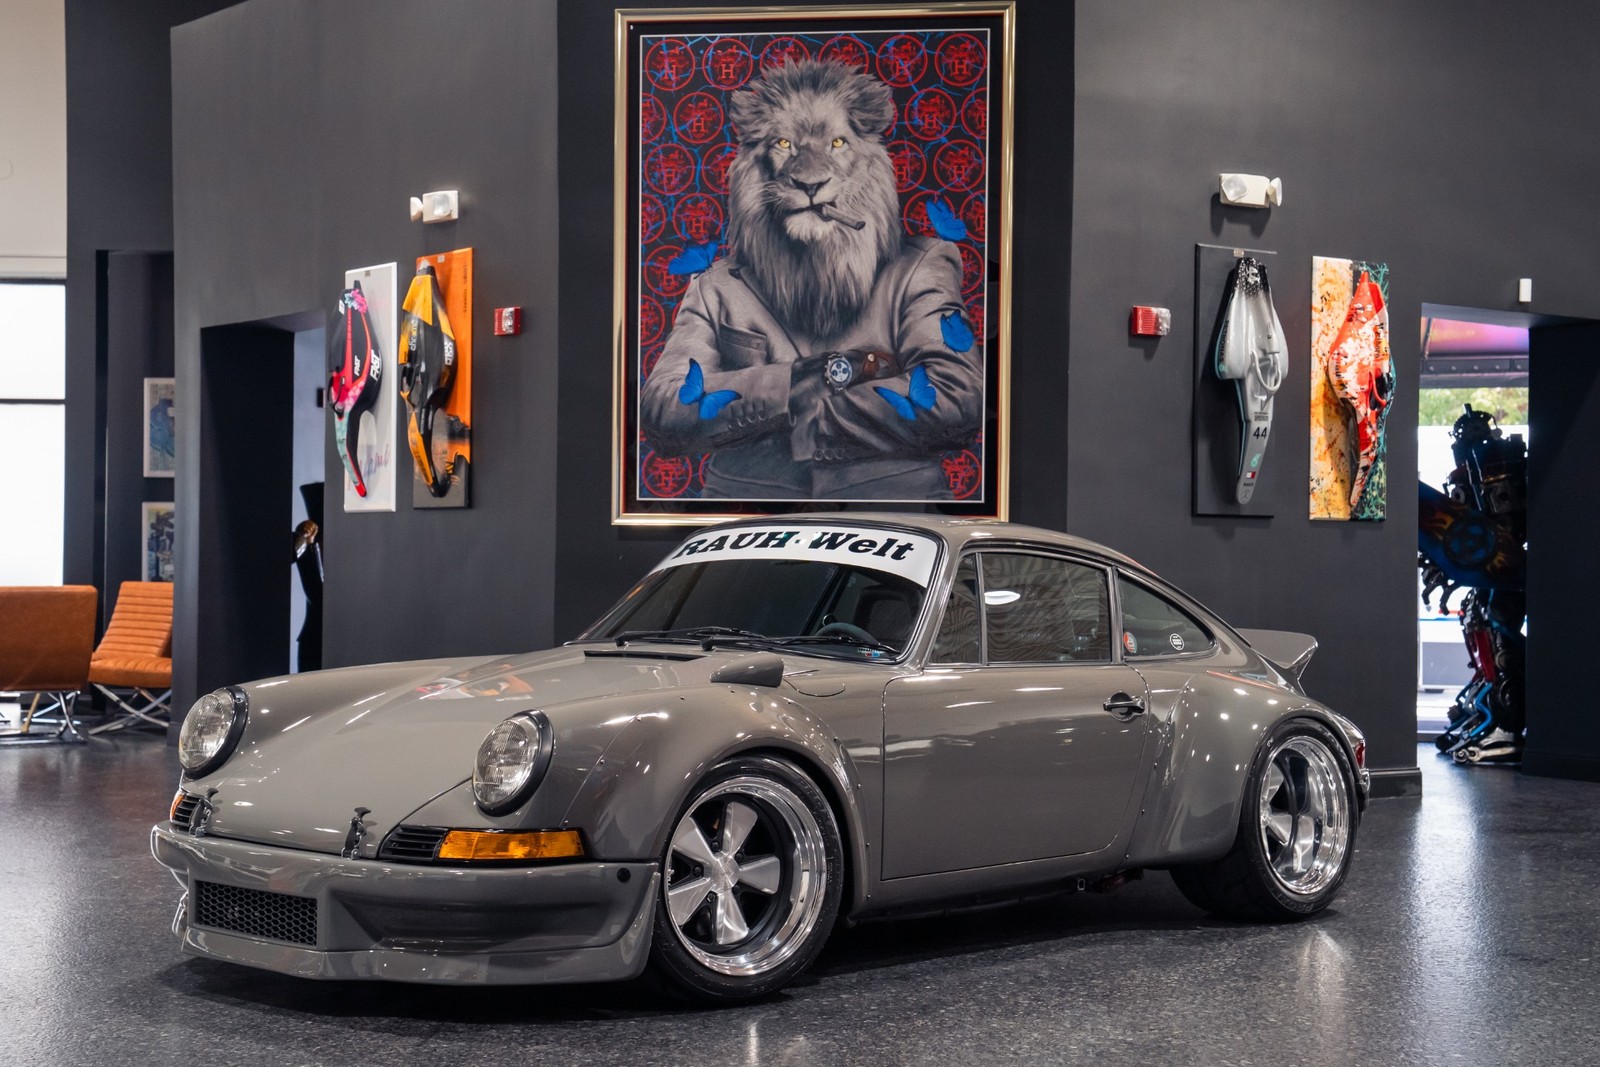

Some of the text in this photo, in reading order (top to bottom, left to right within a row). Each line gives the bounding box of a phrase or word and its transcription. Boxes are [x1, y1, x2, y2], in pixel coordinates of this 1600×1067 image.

[721, 64, 735, 79] H
[953, 59, 968, 75] H
[692, 117, 707, 132] H
[1253, 427, 1267, 439] 44
